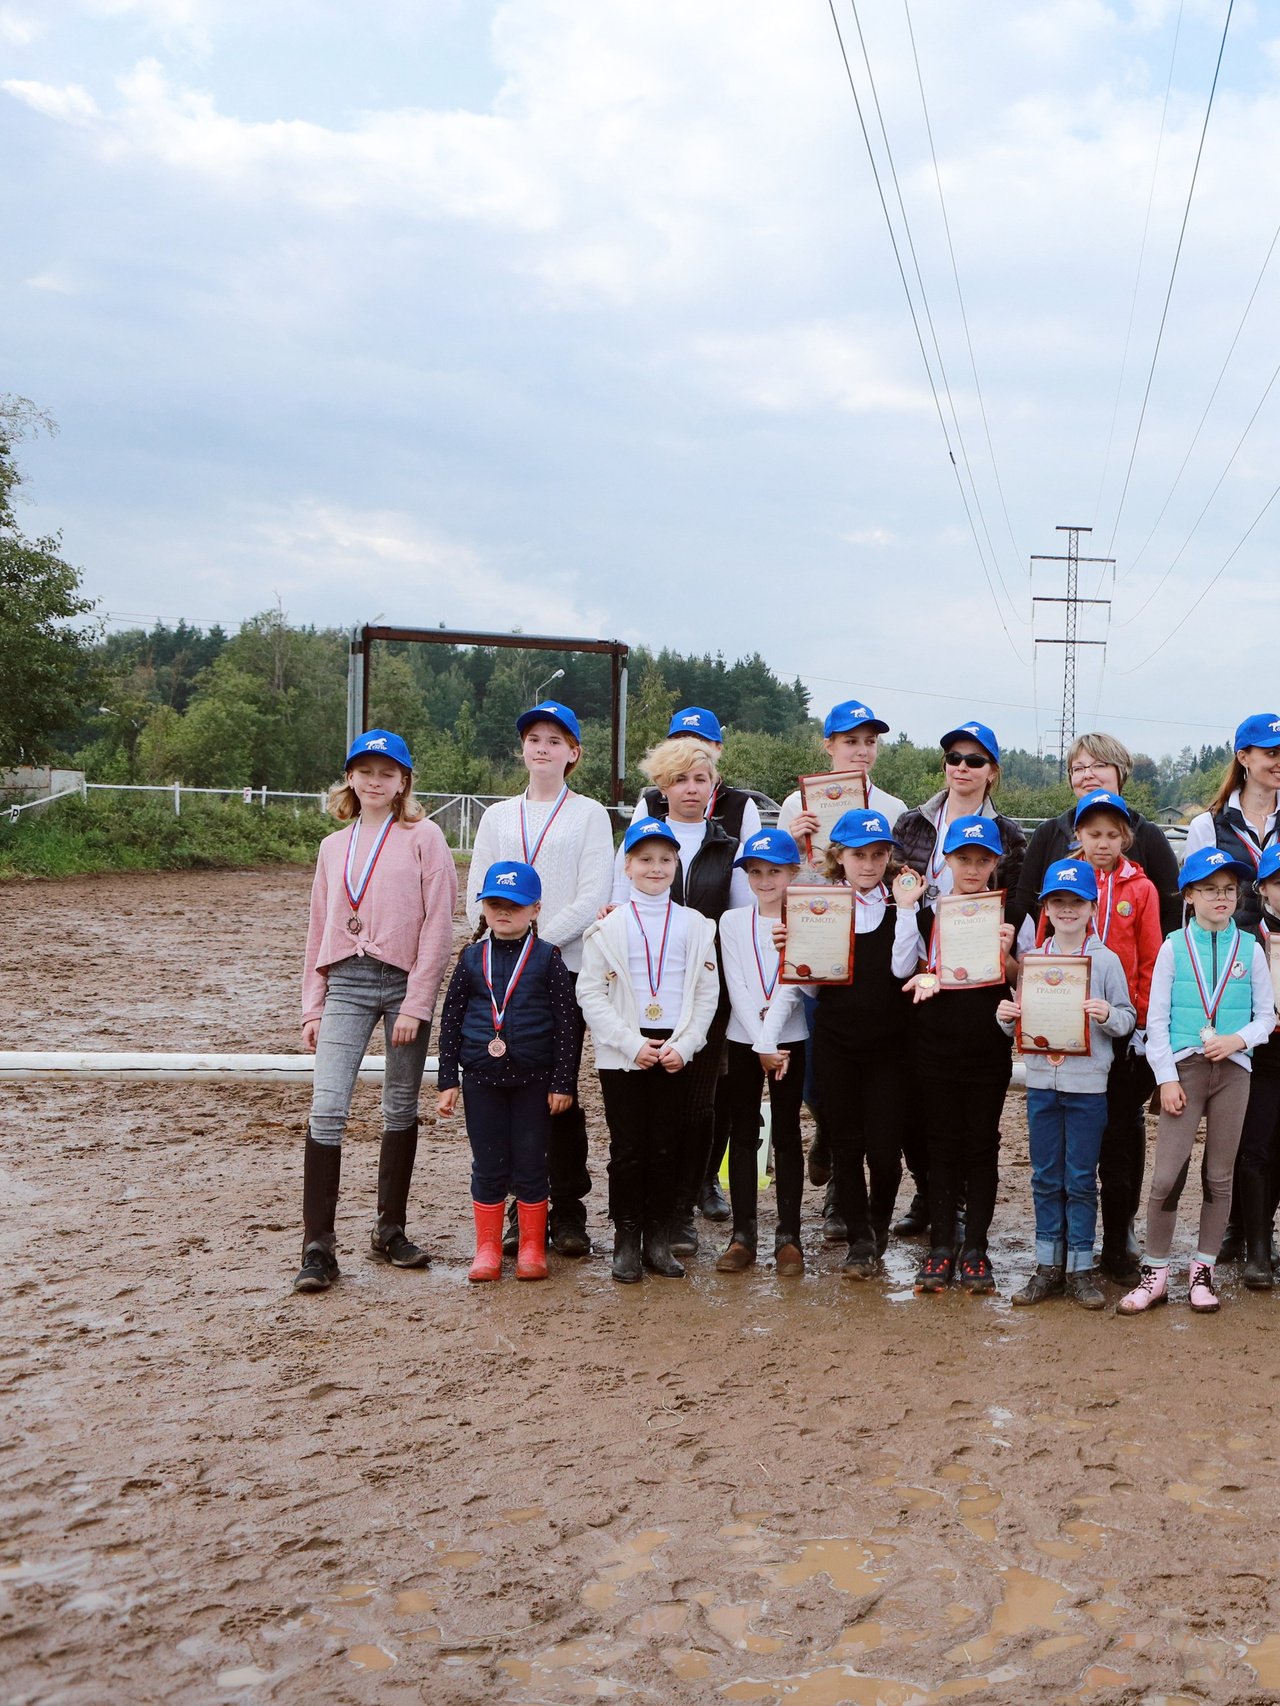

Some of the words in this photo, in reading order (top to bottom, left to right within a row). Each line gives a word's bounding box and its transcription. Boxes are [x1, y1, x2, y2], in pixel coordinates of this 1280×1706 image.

[820, 800, 852, 809] ГРАМОТА
[11, 808, 19, 821] P
[801, 916, 836, 924] ГРАМОТА
[953, 917, 986, 925] ГРАМОТА
[1036, 987, 1071, 995] ГРАМОТА
